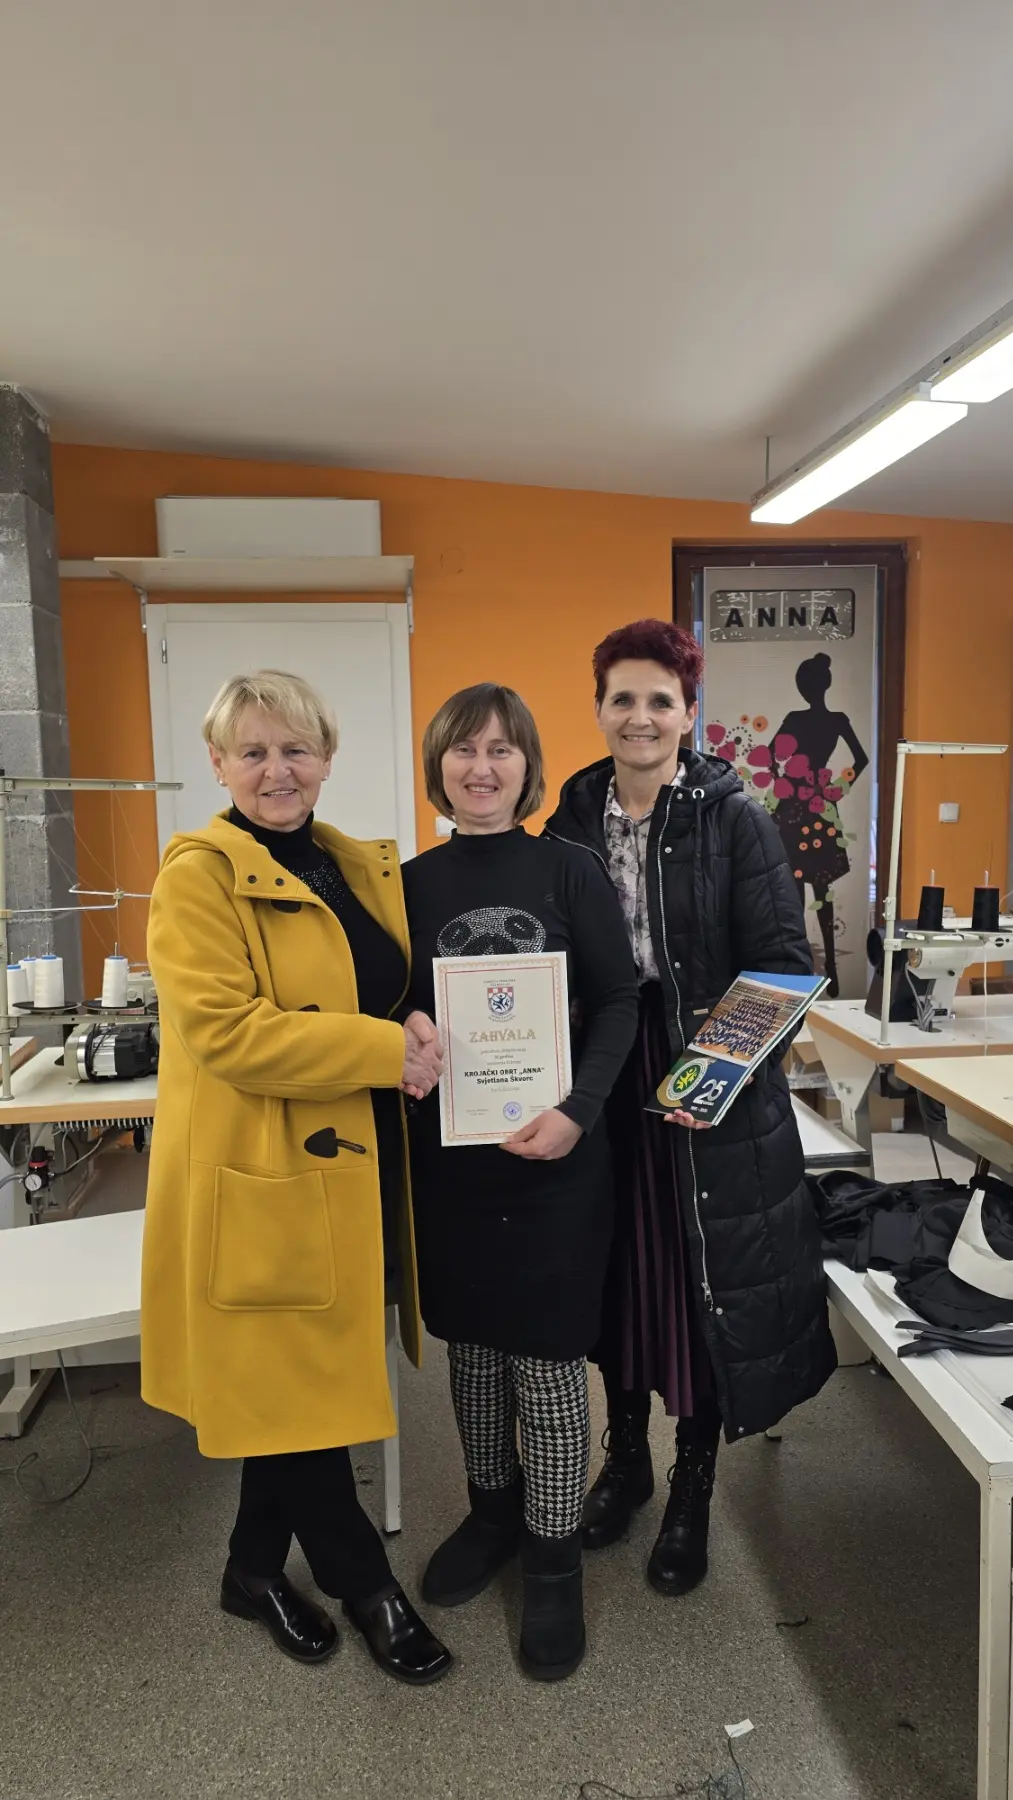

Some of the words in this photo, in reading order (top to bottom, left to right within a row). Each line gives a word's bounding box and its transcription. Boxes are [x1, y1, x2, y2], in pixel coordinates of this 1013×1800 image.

[724, 606, 839, 628] ANNA
[469, 1028, 536, 1043] ZAHVALA
[464, 1069, 498, 1077] KROJAČKI
[476, 1077, 509, 1085] Svjetlana
[509, 1075, 534, 1083] Škvorc
[692, 1078, 728, 1104] 25
